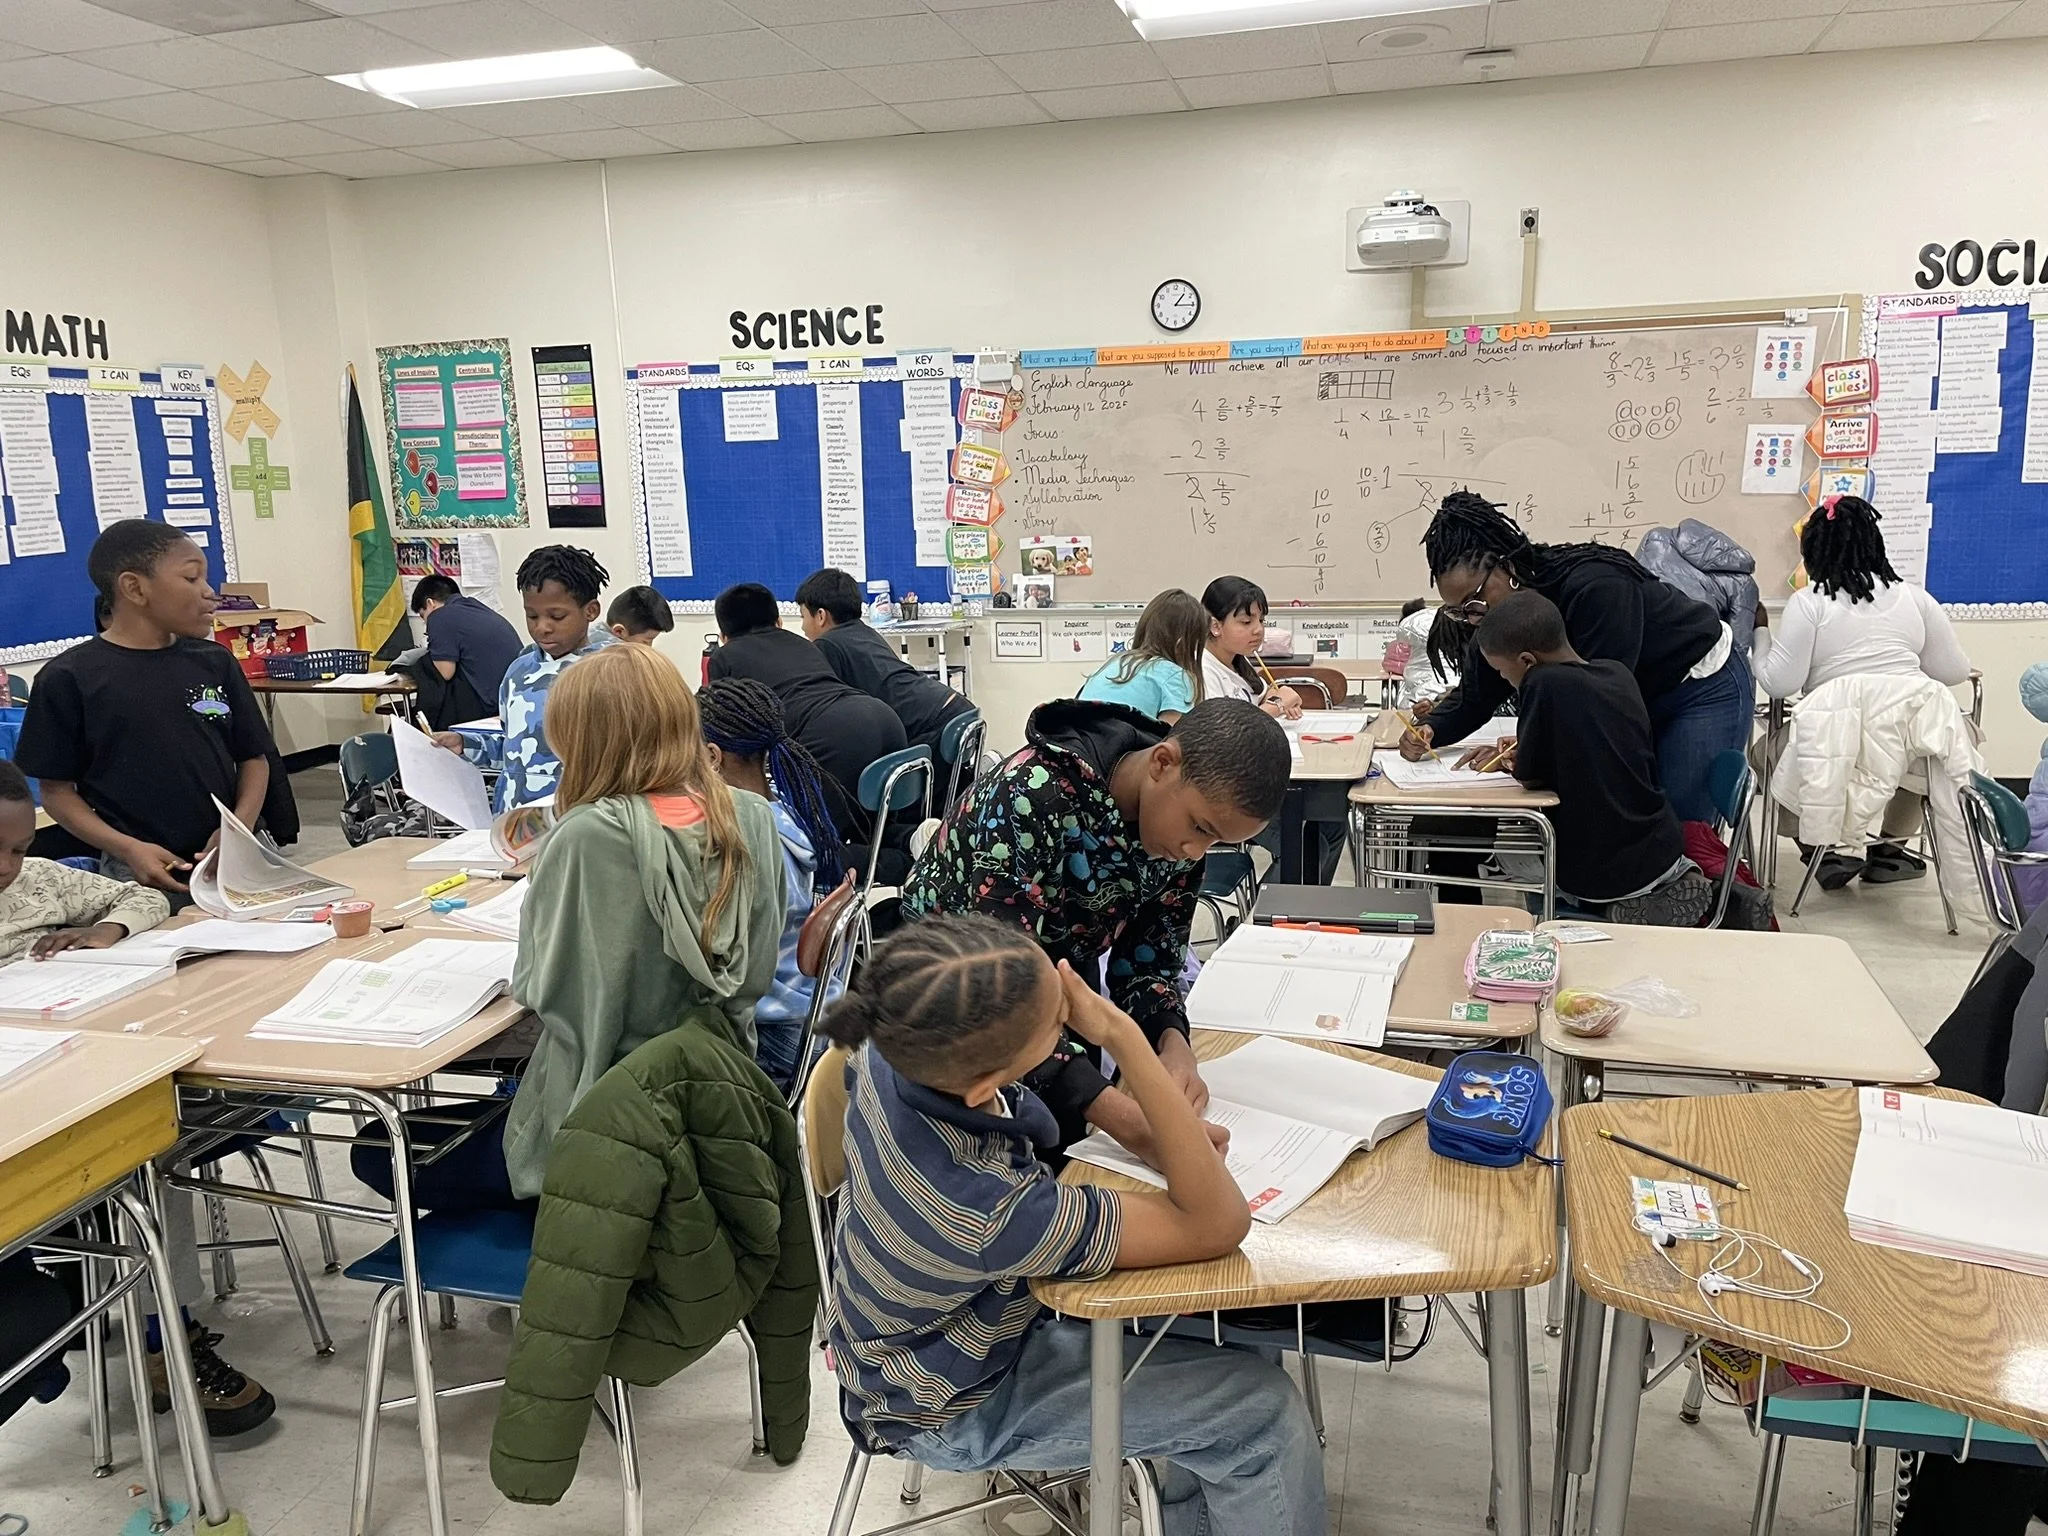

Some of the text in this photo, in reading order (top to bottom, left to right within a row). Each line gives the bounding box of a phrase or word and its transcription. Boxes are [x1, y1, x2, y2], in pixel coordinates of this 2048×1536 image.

[1882, 295, 1956, 311] STANDARDS
[729, 304, 884, 350] SCIENCE
[6, 309, 109, 361] MATH
[1303, 340, 1319, 351] What
[1335, 341, 1347, 351] you
[1350, 340, 1368, 351] going
[1372, 337, 1381, 346] to
[1384, 337, 1394, 346] do
[1396, 335, 1417, 345] about
[1097, 351, 1113, 361] What
[1131, 352, 1144, 362] you
[1147, 350, 1176, 362] supposed
[1179, 350, 1186, 358] to
[1187, 348, 1196, 357] be
[1231, 345, 1244, 354] Are
[1249, 348, 1261, 356] you
[1265, 344, 1285, 355] doing
[915, 354, 933, 365] KEY
[1059, 355, 1068, 364] you
[1164, 361, 1179, 376] We
[1189, 360, 1216, 375] WILL
[1229, 360, 1265, 371] achieve
[1275, 356, 1289, 368] all
[1298, 359, 1314, 367] our
[1384, 354, 1400, 363] are
[1477, 339, 1518, 355] focused
[1522, 343, 1533, 351] on
[735, 361, 755, 372] EQs
[829, 360, 850, 369] CAN
[10, 366, 31, 378] EQs
[110, 370, 129, 380] CAN
[177, 370, 193, 379] KEY
[639, 368, 687, 378] STANDARDS
[906, 367, 945, 378] WORDS
[1827, 369, 1861, 383] class
[170, 382, 201, 392] WORDS
[1031, 366, 1133, 399] English Language
[235, 396, 261, 405] multiply
[971, 397, 999, 410] class
[1026, 394, 1081, 421] February
[1083, 402, 1095, 412] 12
[970, 407, 1001, 420] rules!
[1829, 419, 1863, 429] Arrive
[1834, 428, 1846, 436] on
[1825, 441, 1866, 452] prepared
[1017, 446, 1088, 470] Vocabulary
[975, 461, 993, 471] calm
[1020, 464, 1135, 492] Media Techniques
[961, 489, 981, 498] Raise
[1022, 507, 1058, 536] Story
[953, 532, 965, 540] Say
[973, 543, 986, 551] you
[974, 579, 988, 587] fun
[1064, 620, 1089, 628] Inquirer
[1302, 622, 1349, 630] Knowledgeable
[1492, 1065, 1537, 1129] SONIC
